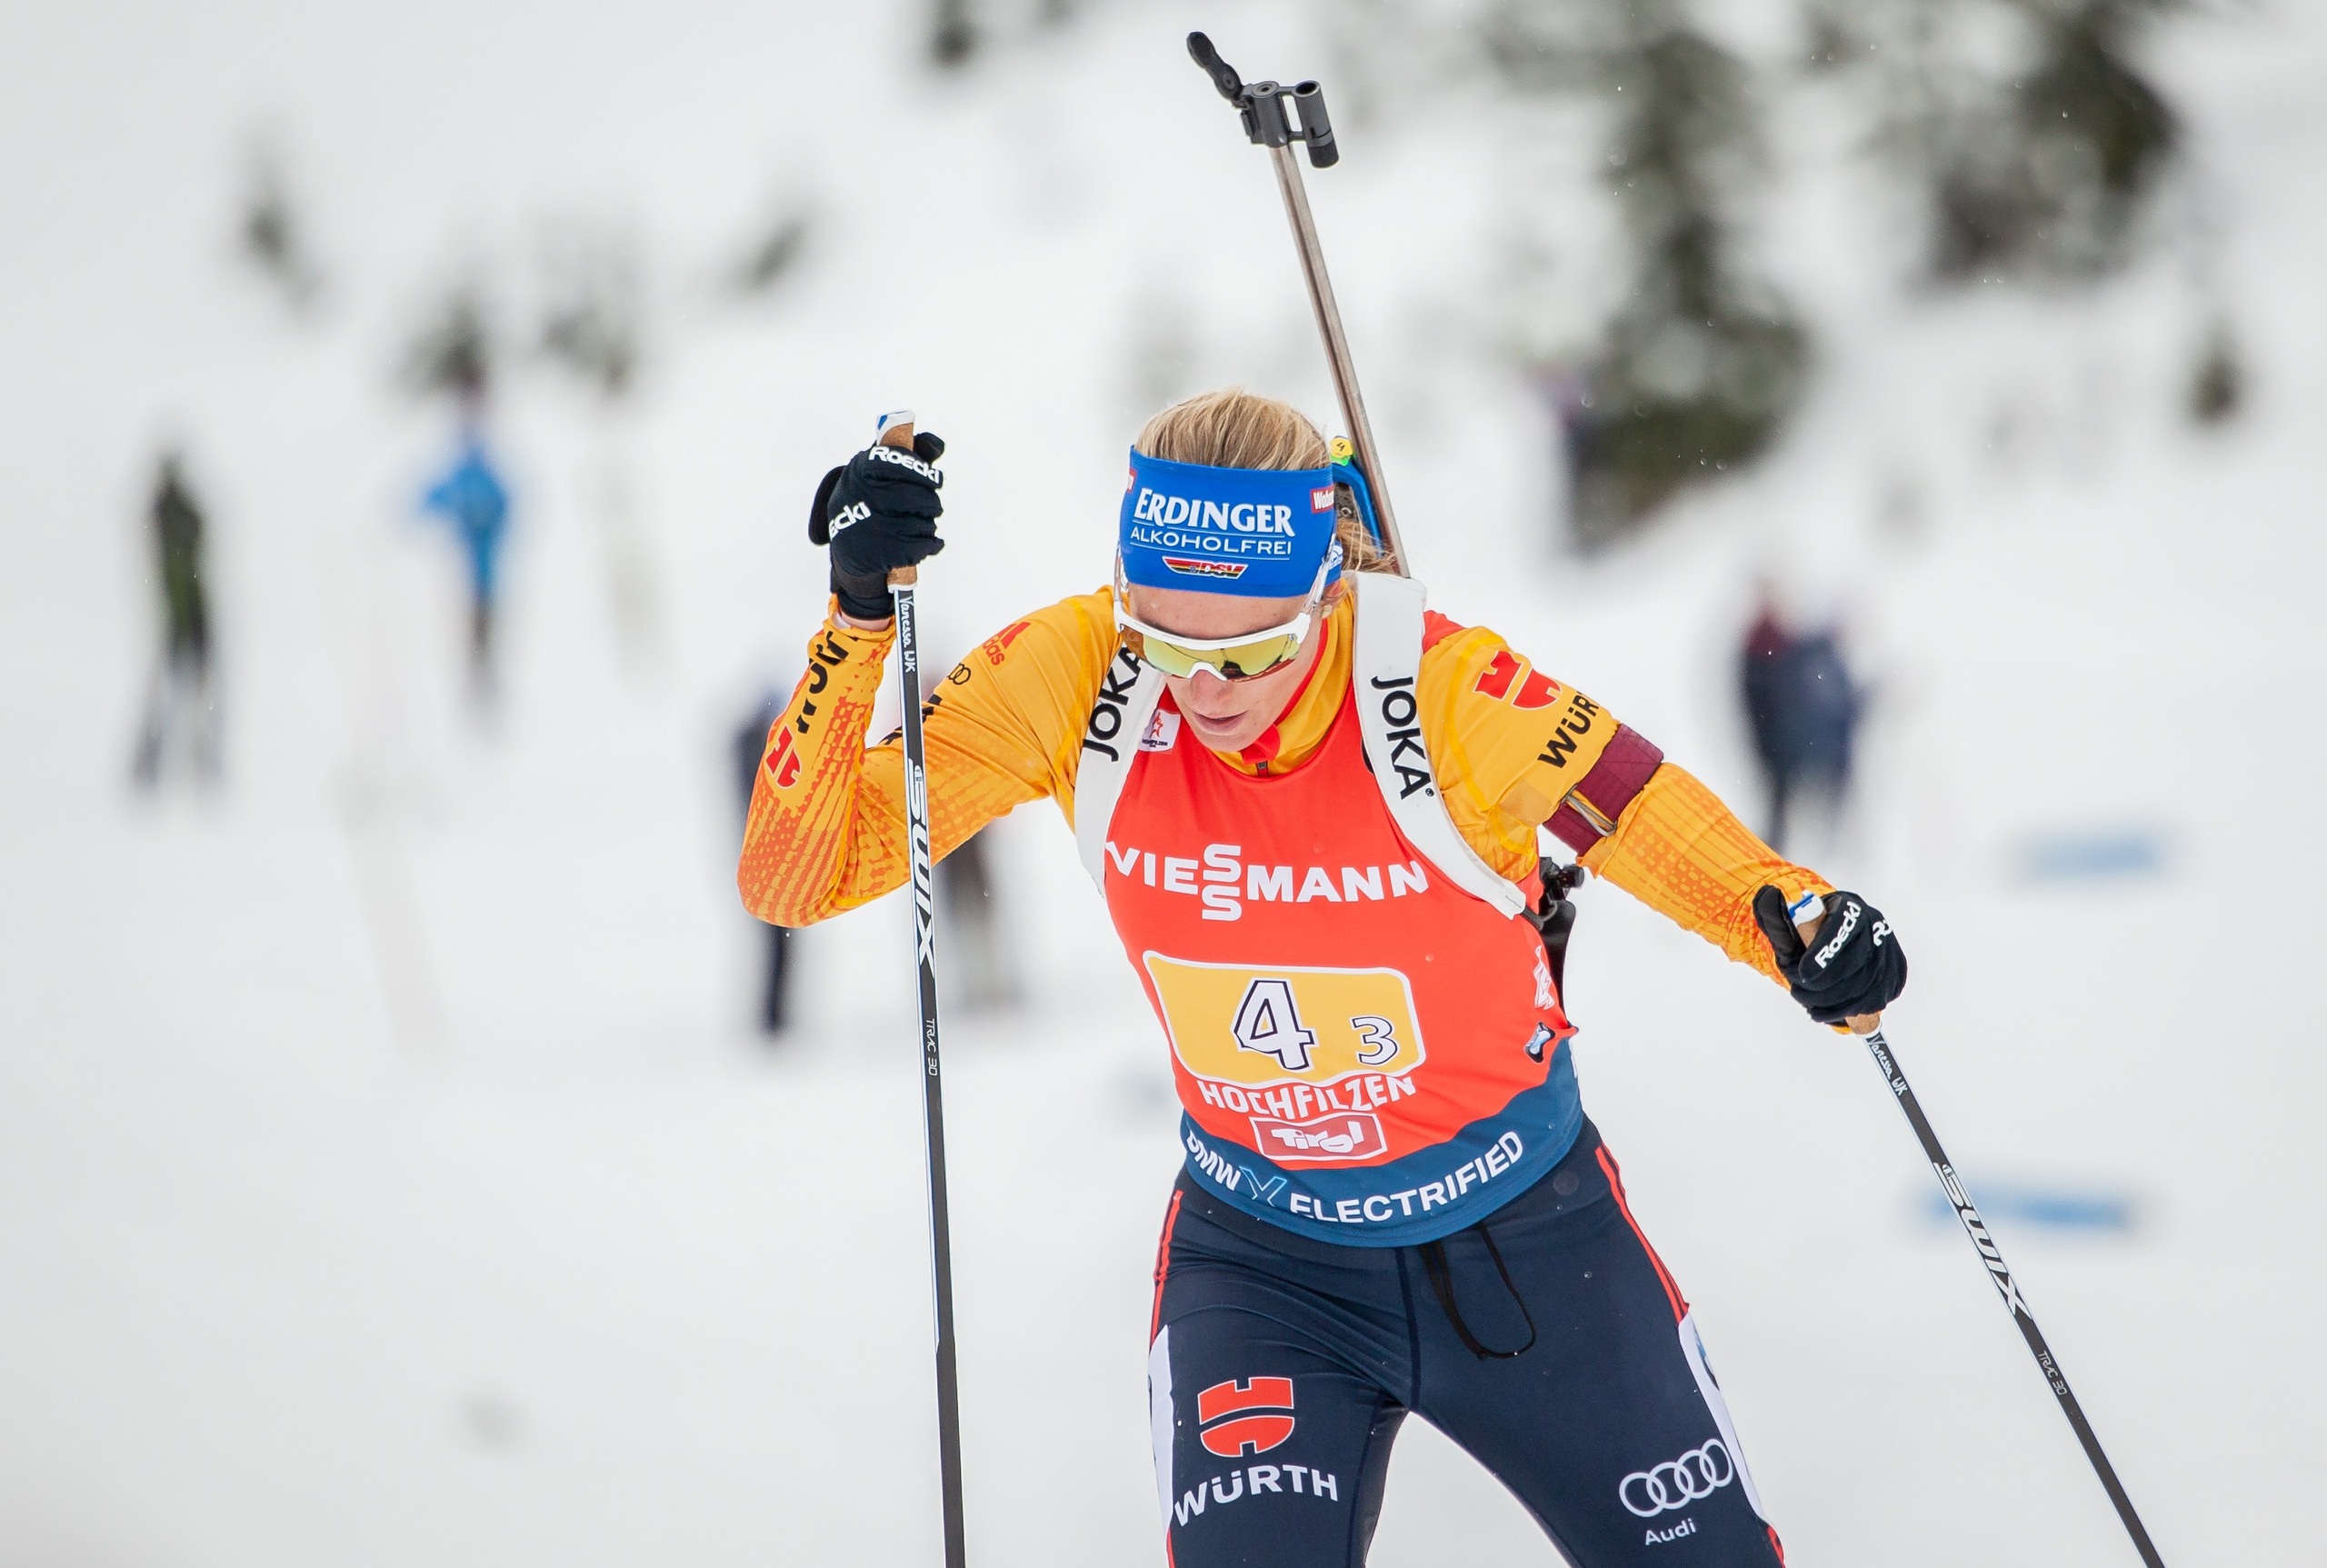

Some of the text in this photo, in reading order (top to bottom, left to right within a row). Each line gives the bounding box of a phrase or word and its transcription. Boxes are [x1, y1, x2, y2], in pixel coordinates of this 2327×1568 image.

[1130, 526, 1292, 555] ALKOHOLFREI
[1133, 487, 1296, 537] ERDINGER
[1200, 561, 1248, 579] DSV
[1082, 646, 1142, 763] JOKA
[1537, 692, 1600, 769] WÜR
[1105, 841, 1430, 922] VIESSMANN
[1231, 978, 1400, 1070] 4 3
[1196, 1075, 1417, 1119] HOCHFILZEN
[1290, 1132, 1524, 1223] ELECTRIFIED
[1173, 1464, 1339, 1527] WÜRTH
[1644, 1517, 1697, 1545] Audi
